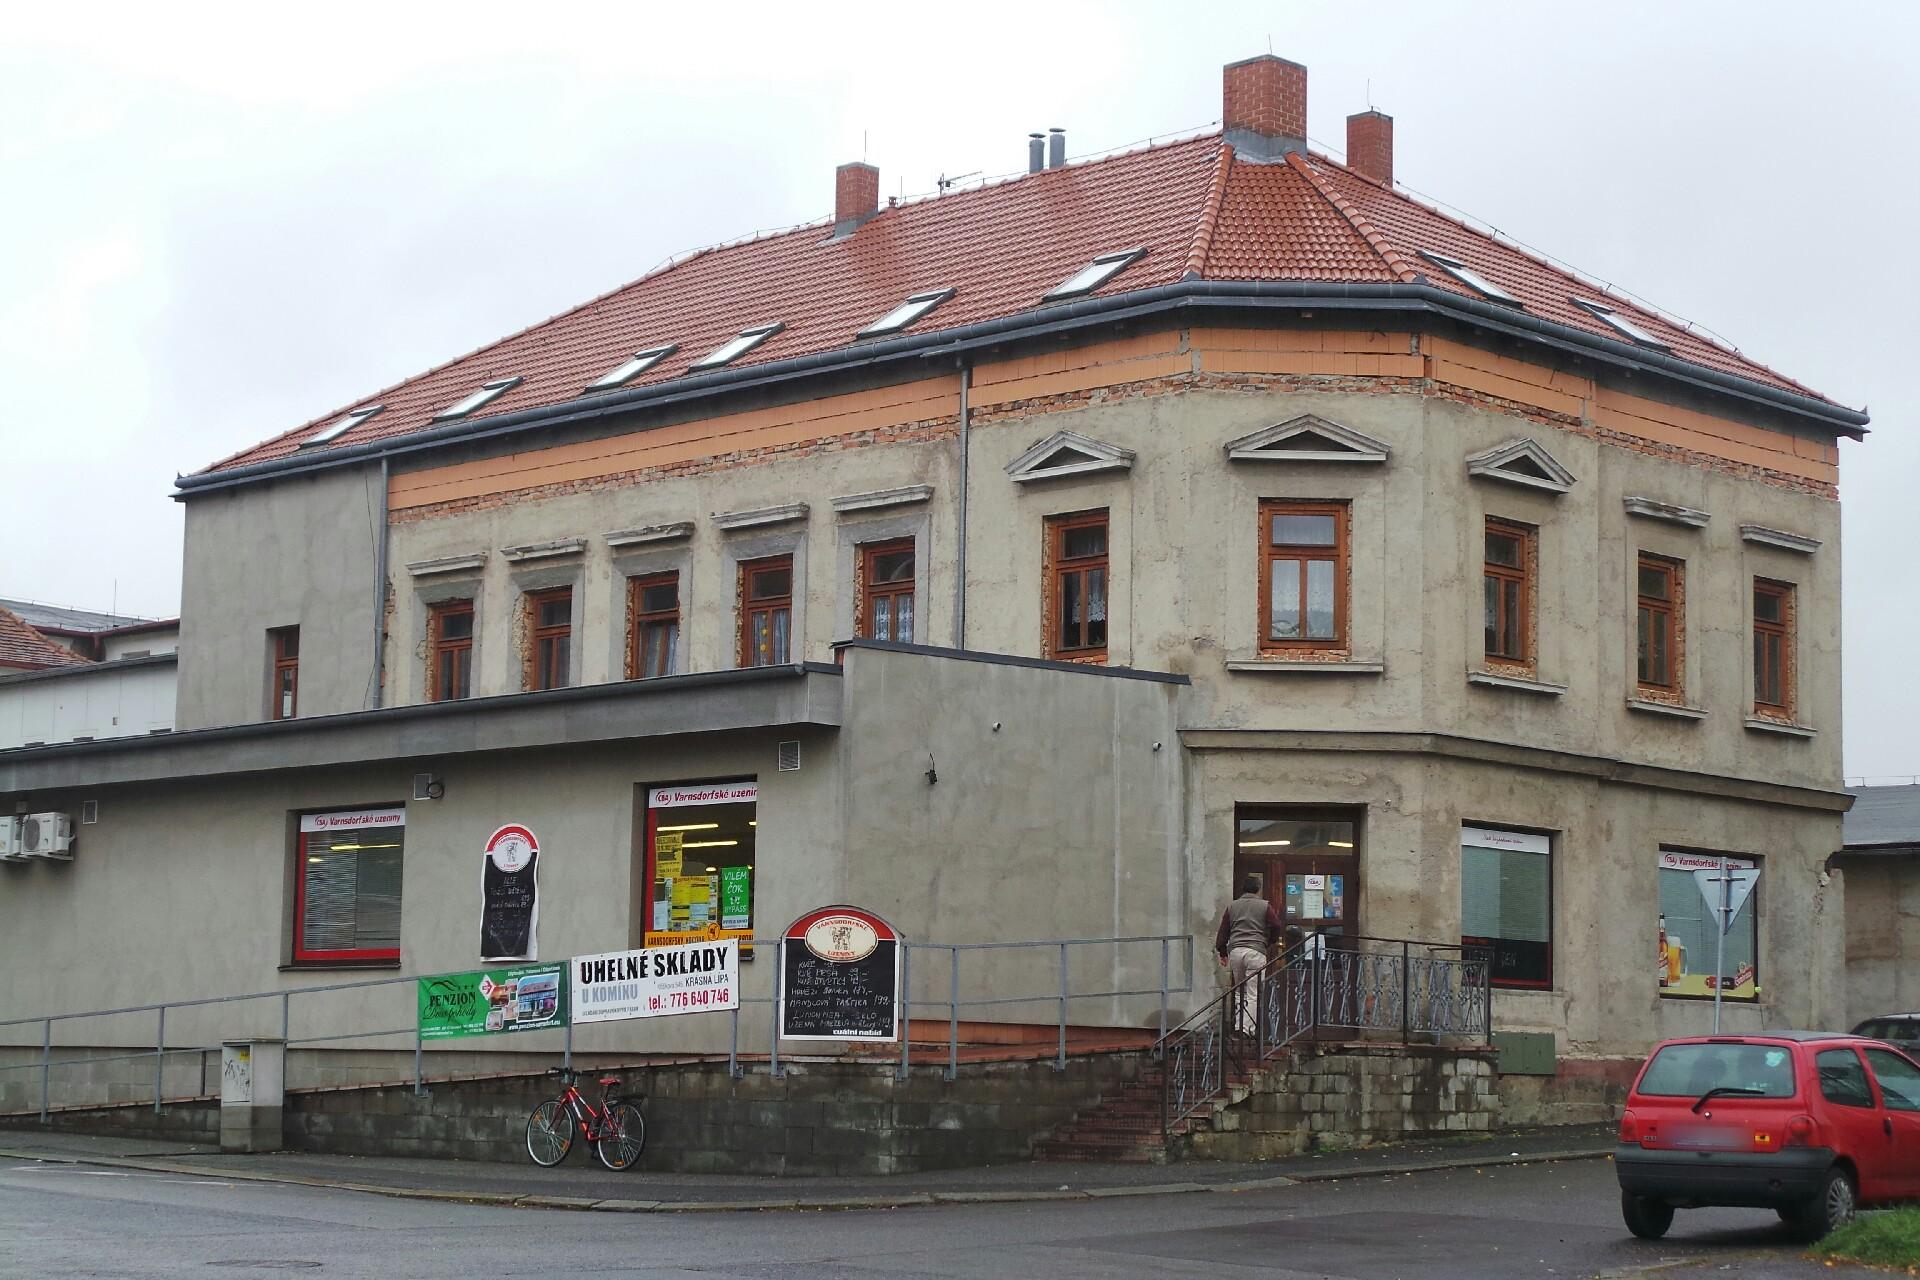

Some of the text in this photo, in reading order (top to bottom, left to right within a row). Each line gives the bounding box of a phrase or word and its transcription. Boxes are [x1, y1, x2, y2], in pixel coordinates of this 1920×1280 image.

[674, 789, 729, 802] Varnsdorfské
[330, 815, 373, 826] Varnsdorfské
[1679, 857, 1718, 868] Varnsdorfské
[581, 947, 728, 984] UHELNÉ SKLADY
[430, 992, 476, 1006] PENZION
[582, 988, 589, 1003] U
[649, 988, 729, 1010] tel.: 776 640 746
